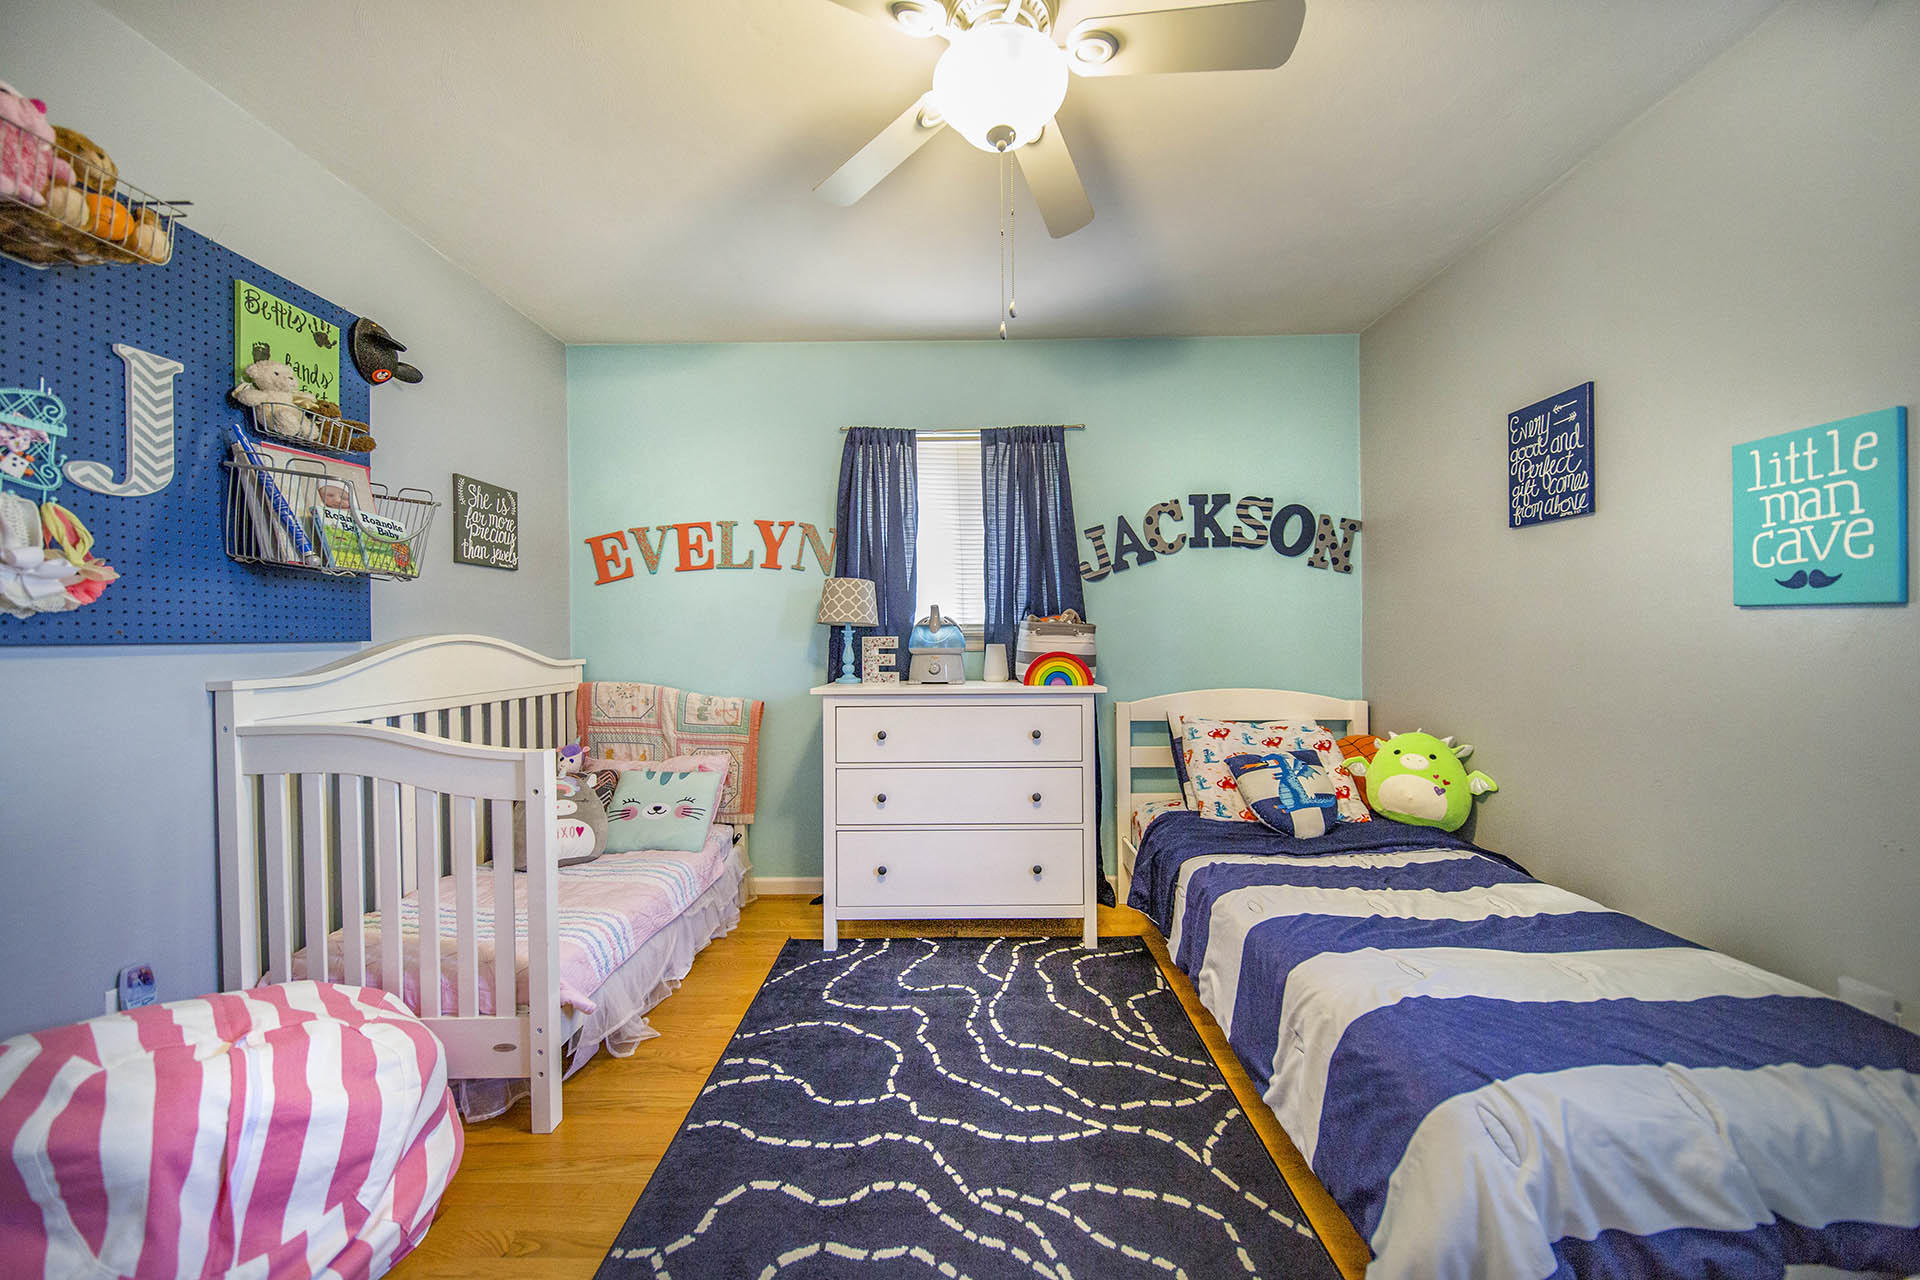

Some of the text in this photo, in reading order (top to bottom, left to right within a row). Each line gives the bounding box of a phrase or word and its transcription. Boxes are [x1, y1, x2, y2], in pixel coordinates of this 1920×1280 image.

[300, 385, 329, 400] fet
[1510, 411, 1550, 447] Every
[1510, 422, 1584, 476] good and
[1747, 429, 1879, 493] little
[468, 483, 511, 516] She is
[1512, 470, 1589, 509] gift comes
[1760, 479, 1867, 529] man
[324, 508, 355, 523] Roan
[361, 513, 404, 533] Roanoke
[464, 506, 517, 533] far more
[1513, 492, 1589, 526] from above
[376, 526, 400, 540] Baby
[1079, 494, 1363, 582] JACKSON
[1751, 517, 1876, 569] cave
[461, 538, 519, 566] than jewels
[584, 520, 837, 586] EVELYN
[861, 636, 900, 685] E
